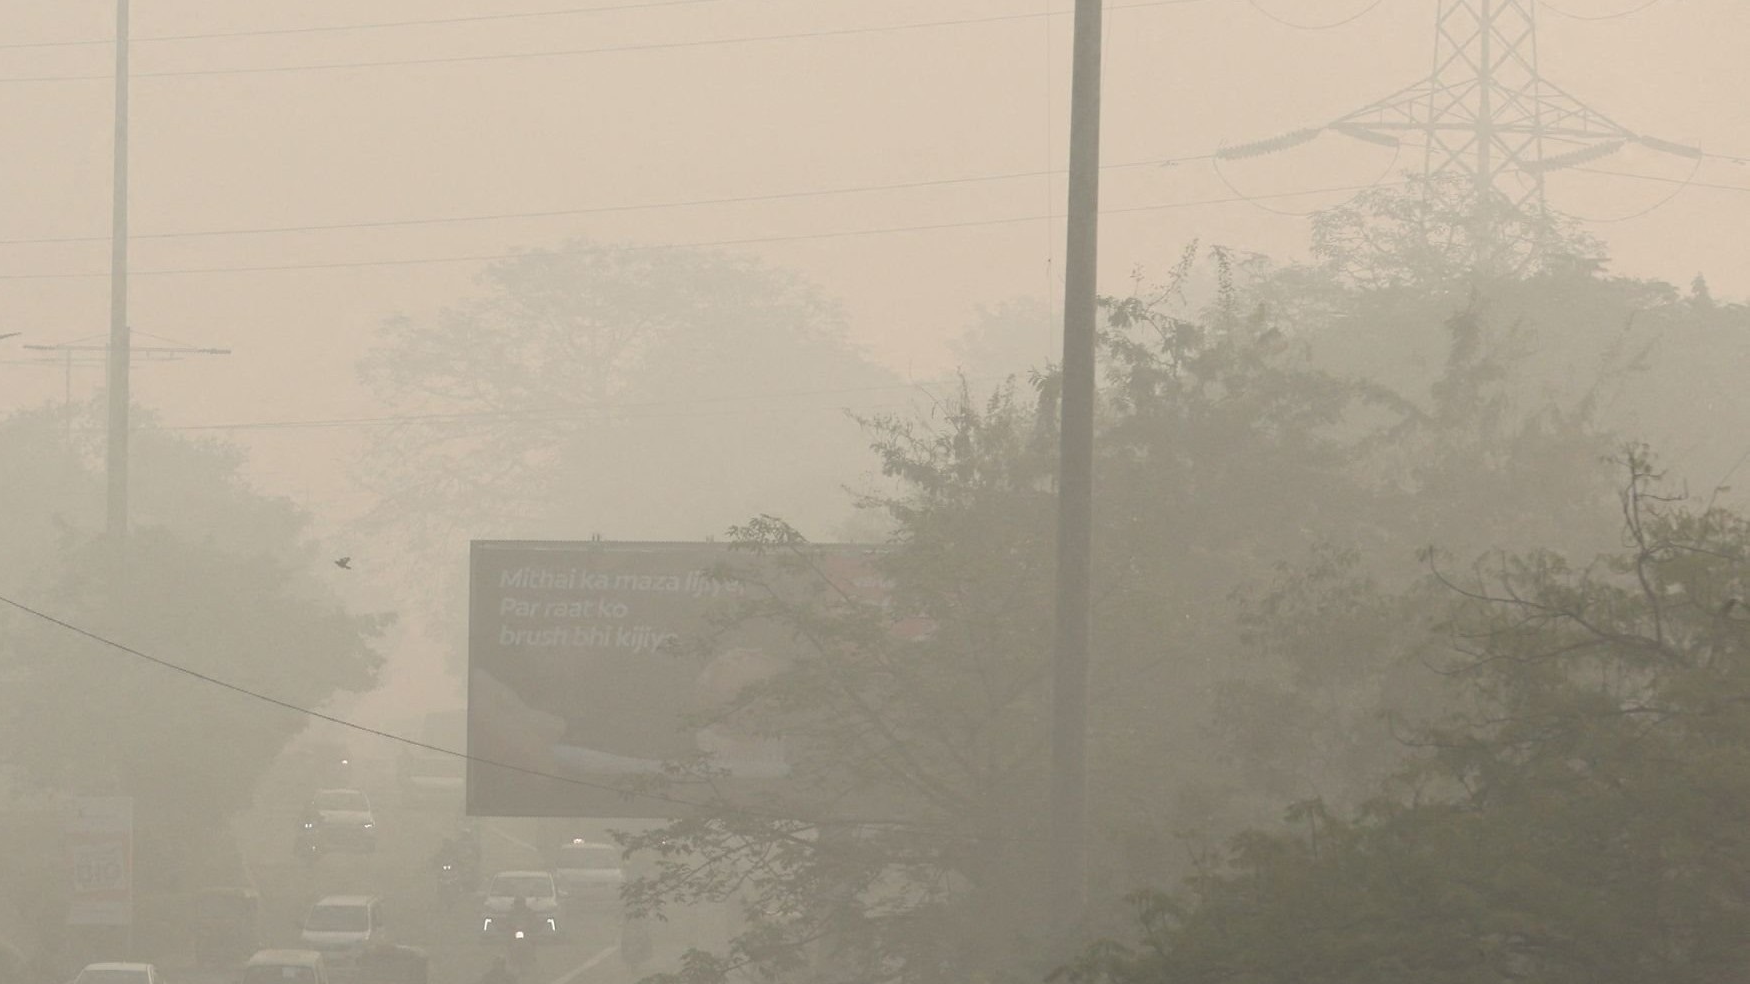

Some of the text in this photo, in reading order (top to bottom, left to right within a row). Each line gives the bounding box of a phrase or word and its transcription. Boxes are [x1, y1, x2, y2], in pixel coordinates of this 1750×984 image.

[498, 567, 577, 589] Mithai
[579, 569, 611, 591] ka
[612, 573, 680, 592] maza
[499, 597, 629, 618] Par raat ko
[499, 624, 568, 646] brush
[571, 624, 611, 647] bhi
